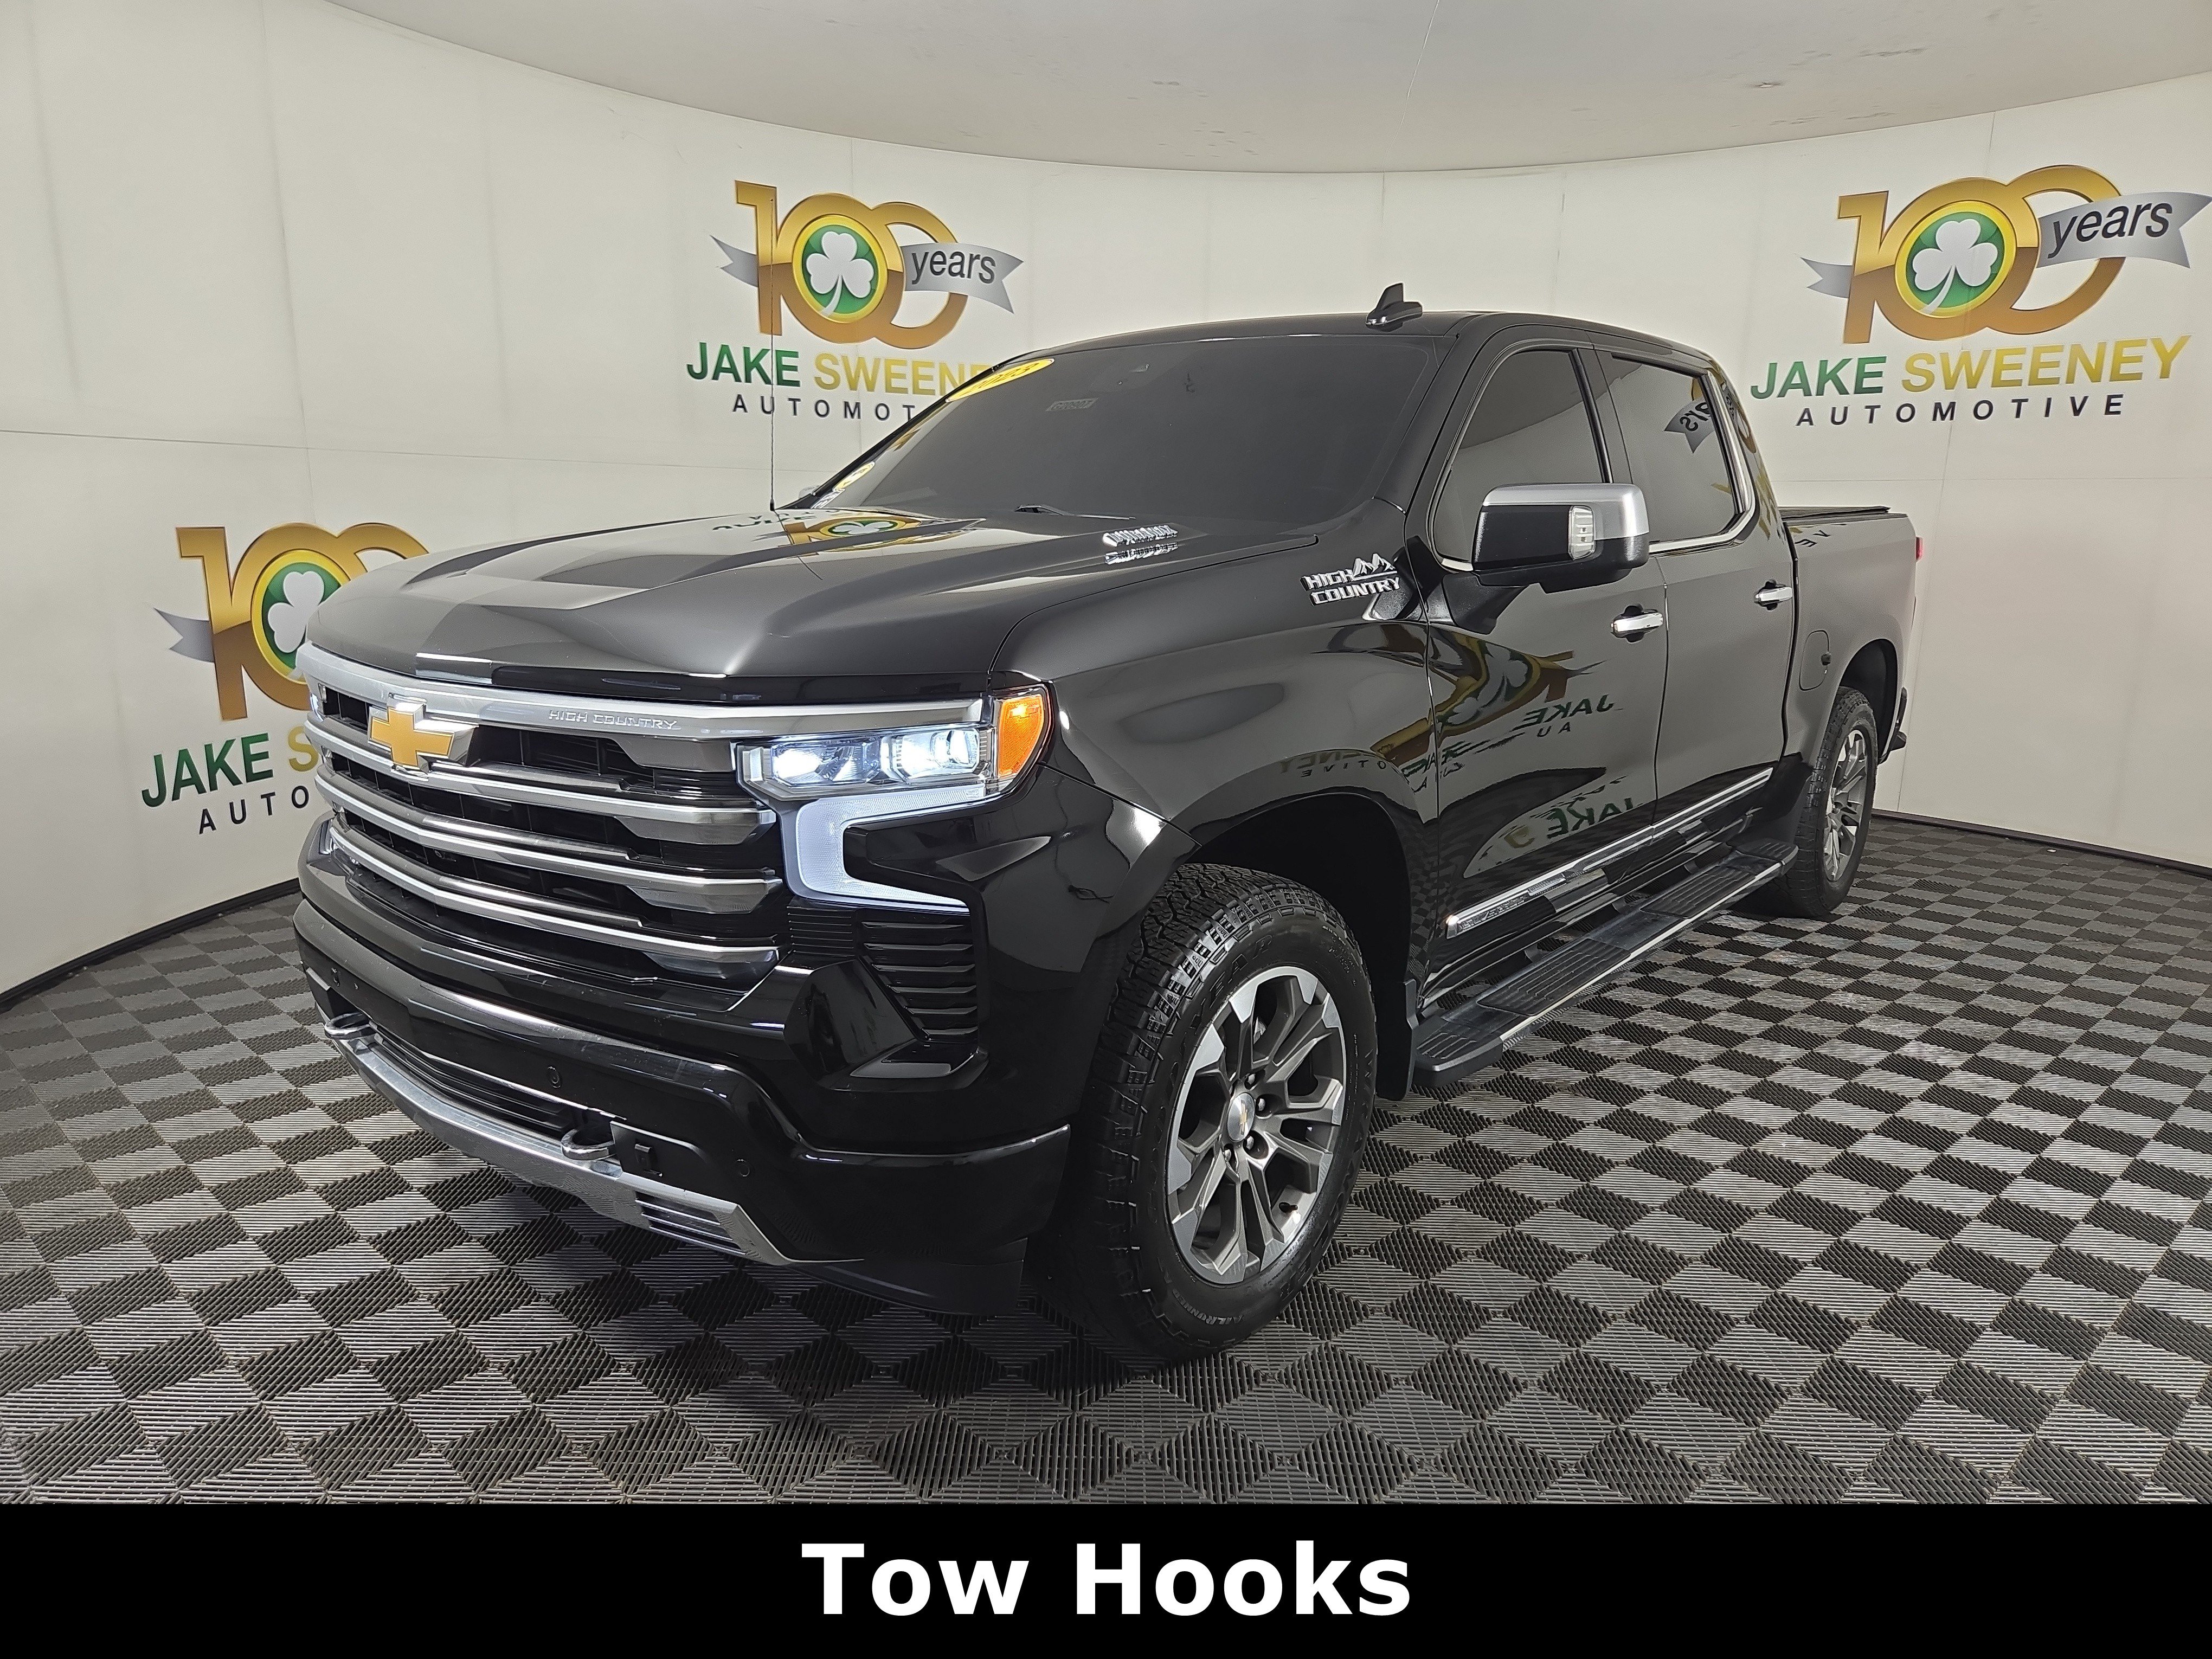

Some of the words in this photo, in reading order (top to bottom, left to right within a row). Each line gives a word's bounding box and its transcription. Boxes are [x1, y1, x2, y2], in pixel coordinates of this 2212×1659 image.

[2047, 202, 2172, 260] years
[911, 250, 996, 285] years
[686, 342, 801, 388] JAKE
[1750, 355, 1888, 400] JAKE
[1901, 335, 2191, 393] SWEENEY
[1796, 394, 2124, 427] AUTOMOTIVE
[1301, 569, 1355, 590] HIGH
[1309, 577, 1400, 605] COUNTRY
[549, 709, 588, 723] HIGH
[593, 714, 678, 730] COUNTRY
[142, 732, 273, 808] JAKE
[198, 785, 310, 835] AUTO
